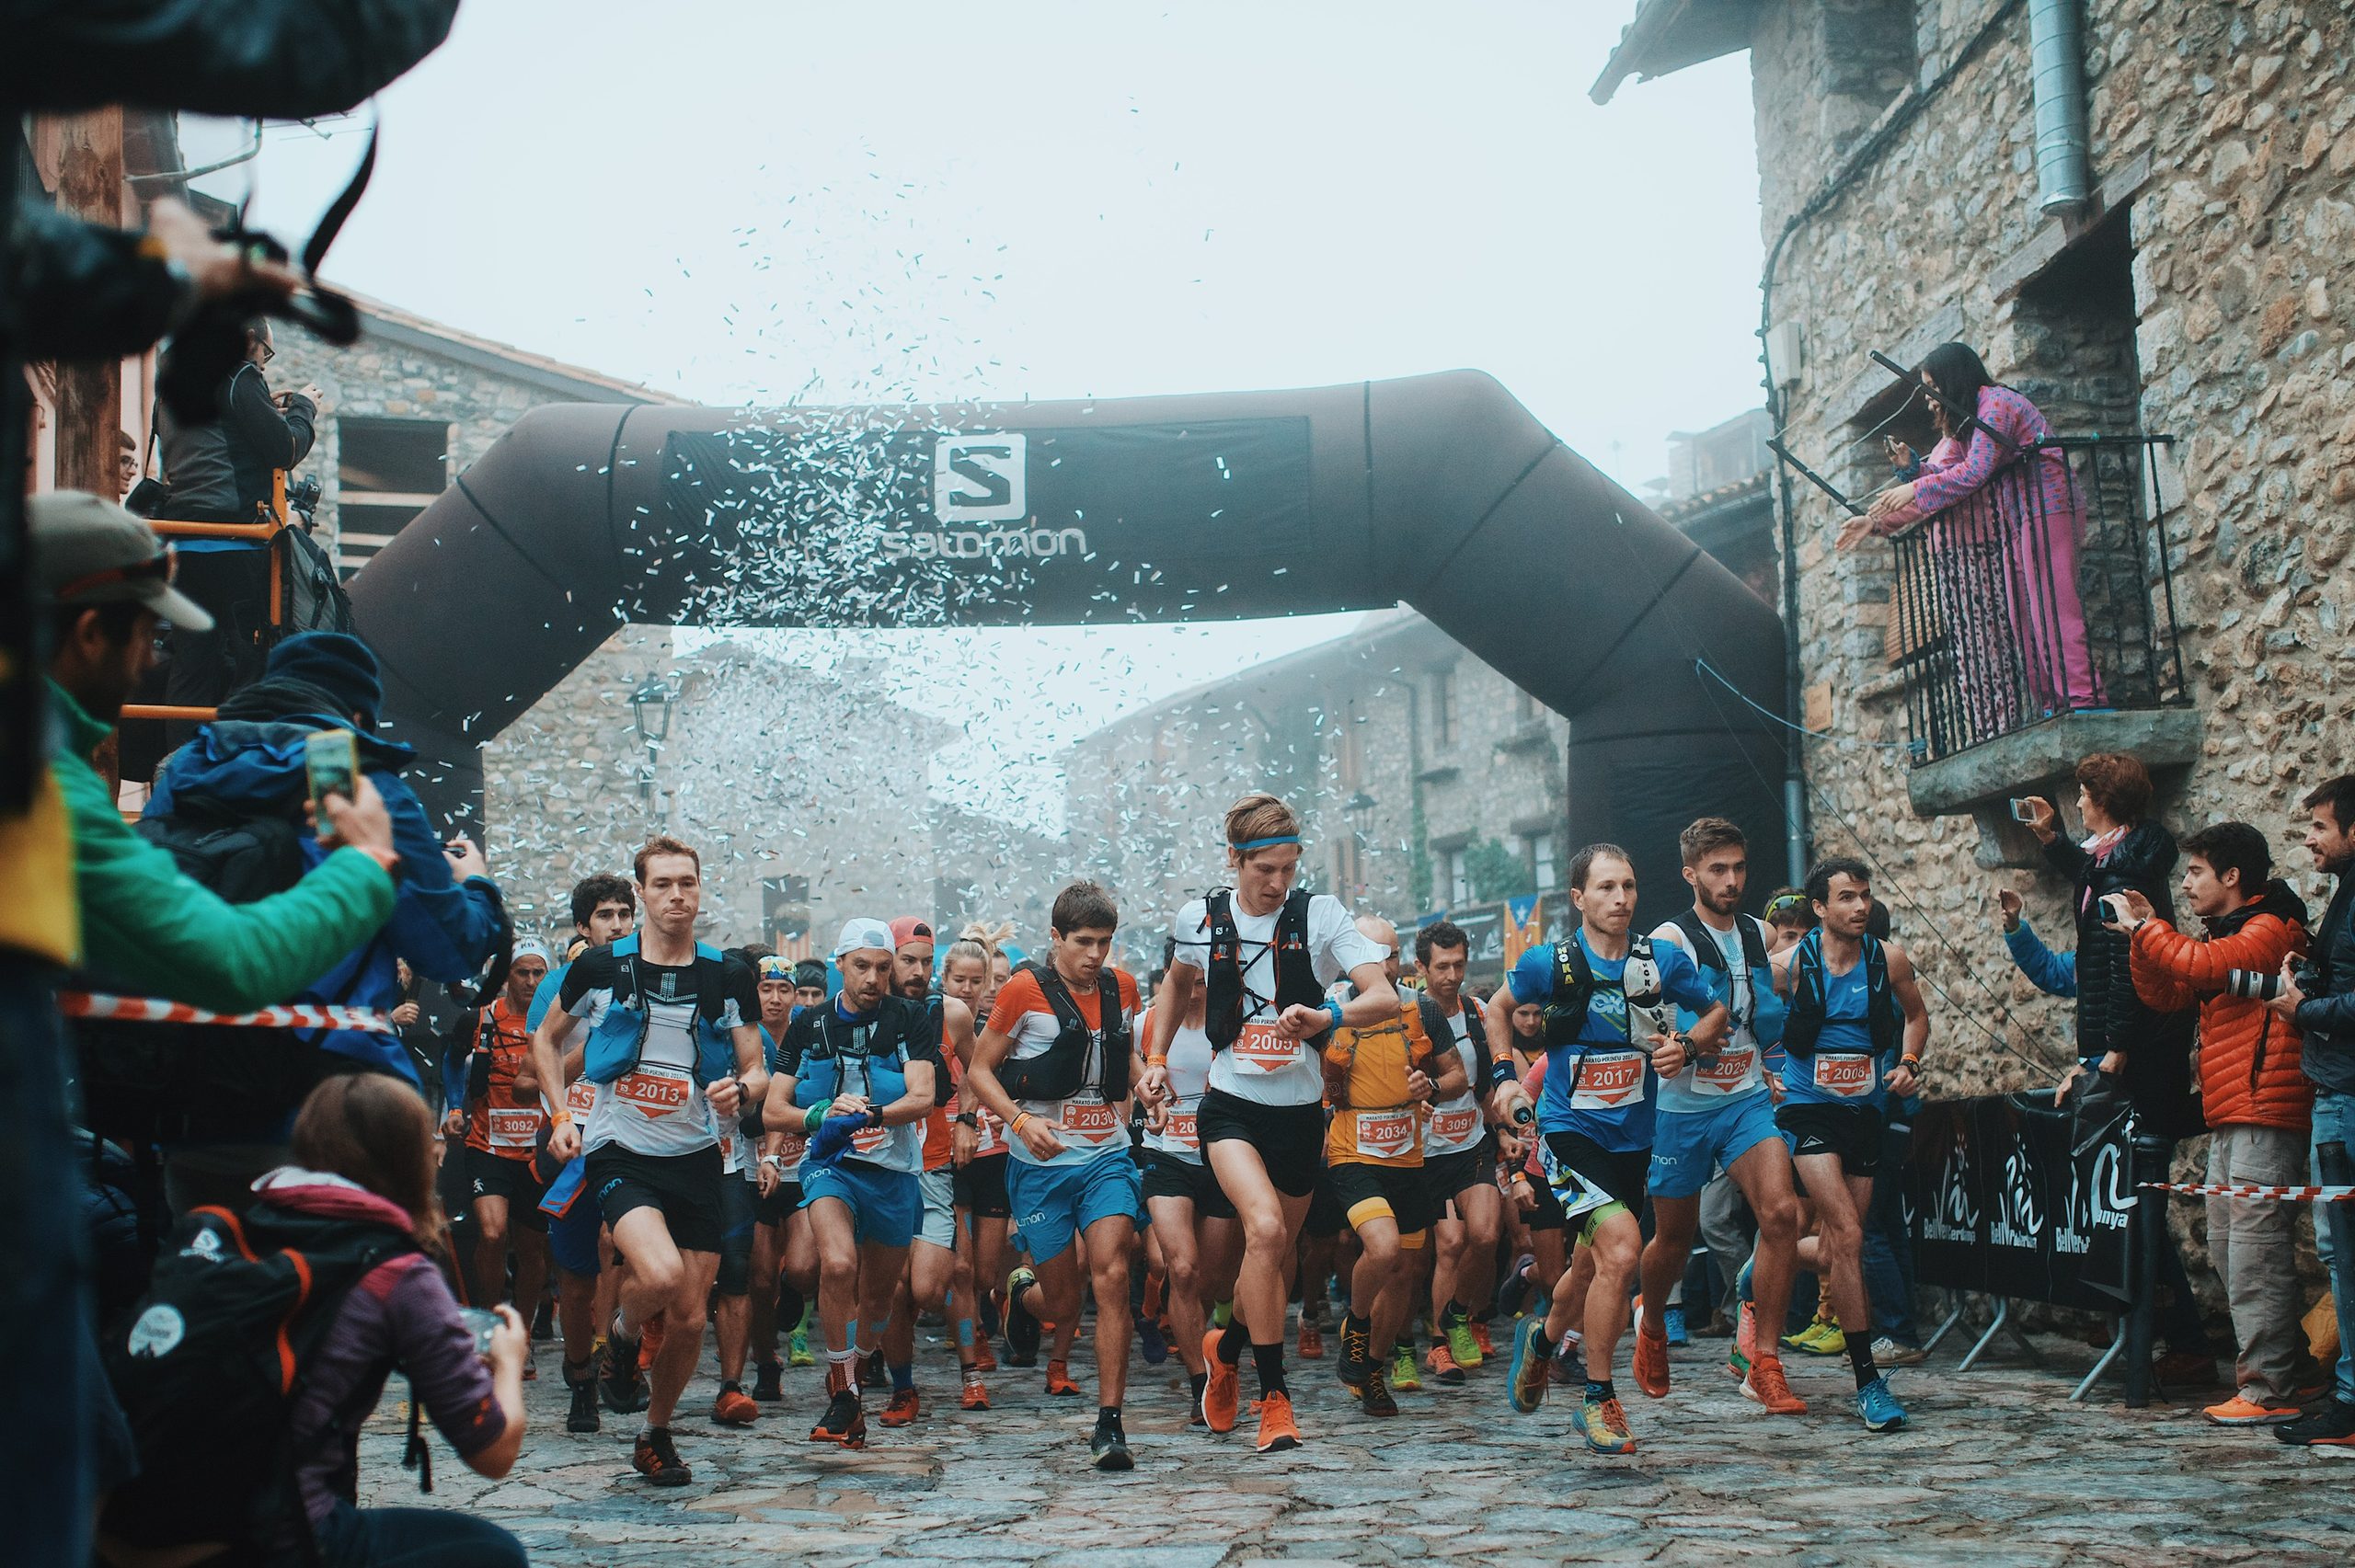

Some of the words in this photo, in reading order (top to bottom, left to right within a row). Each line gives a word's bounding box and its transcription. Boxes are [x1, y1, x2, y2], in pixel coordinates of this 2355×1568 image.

[948, 444, 1013, 509] S
[882, 527, 1087, 559] salomon
[1557, 946, 1575, 985] HOKA
[1714, 1059, 1747, 1076] 2025
[1832, 1065, 1865, 1081] 2008
[1592, 1068, 1635, 1087] 2017
[635, 1082, 680, 1103] 2013
[504, 1120, 534, 1131] 3092
[1080, 1110, 1114, 1127] 2030
[1447, 1116, 1473, 1131] 3091
[1178, 1121, 1198, 1134] 20
[1375, 1124, 1407, 1140] 2034
